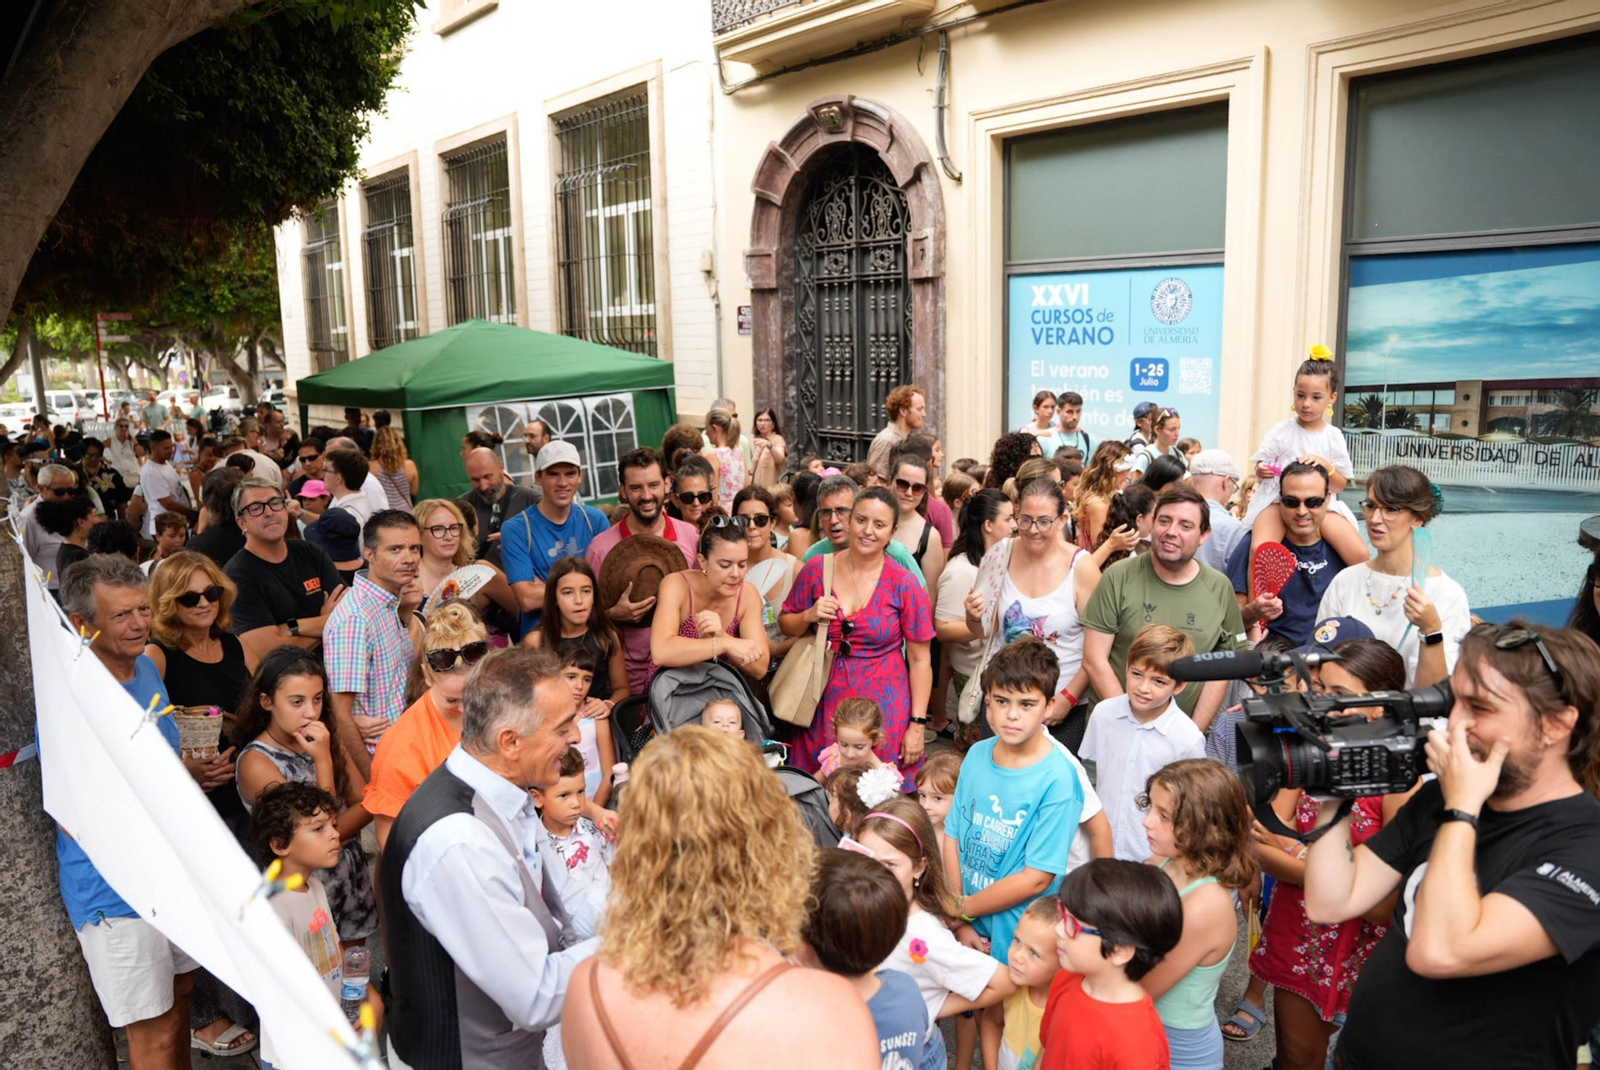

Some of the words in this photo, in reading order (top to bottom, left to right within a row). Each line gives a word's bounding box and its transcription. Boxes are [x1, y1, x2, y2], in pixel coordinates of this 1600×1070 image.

[1031, 283, 1089, 306] XXVI
[1031, 308, 1093, 325] CURSOS
[1097, 308, 1114, 323] de
[1031, 326, 1114, 345] VERANO
[1143, 326, 1199, 335] UNIVERSIDAD
[1144, 335, 1154, 343] DE
[1031, 360, 1044, 377] El
[1049, 365, 1109, 378] verano
[1135, 364, 1164, 377] 1-25
[1139, 377, 1159, 386] Julio
[1104, 389, 1124, 402] es
[1396, 442, 1519, 464] UNIVERSIDAD
[1534, 450, 1561, 467] DE
[880, 1032, 917, 1053] SUNSET
